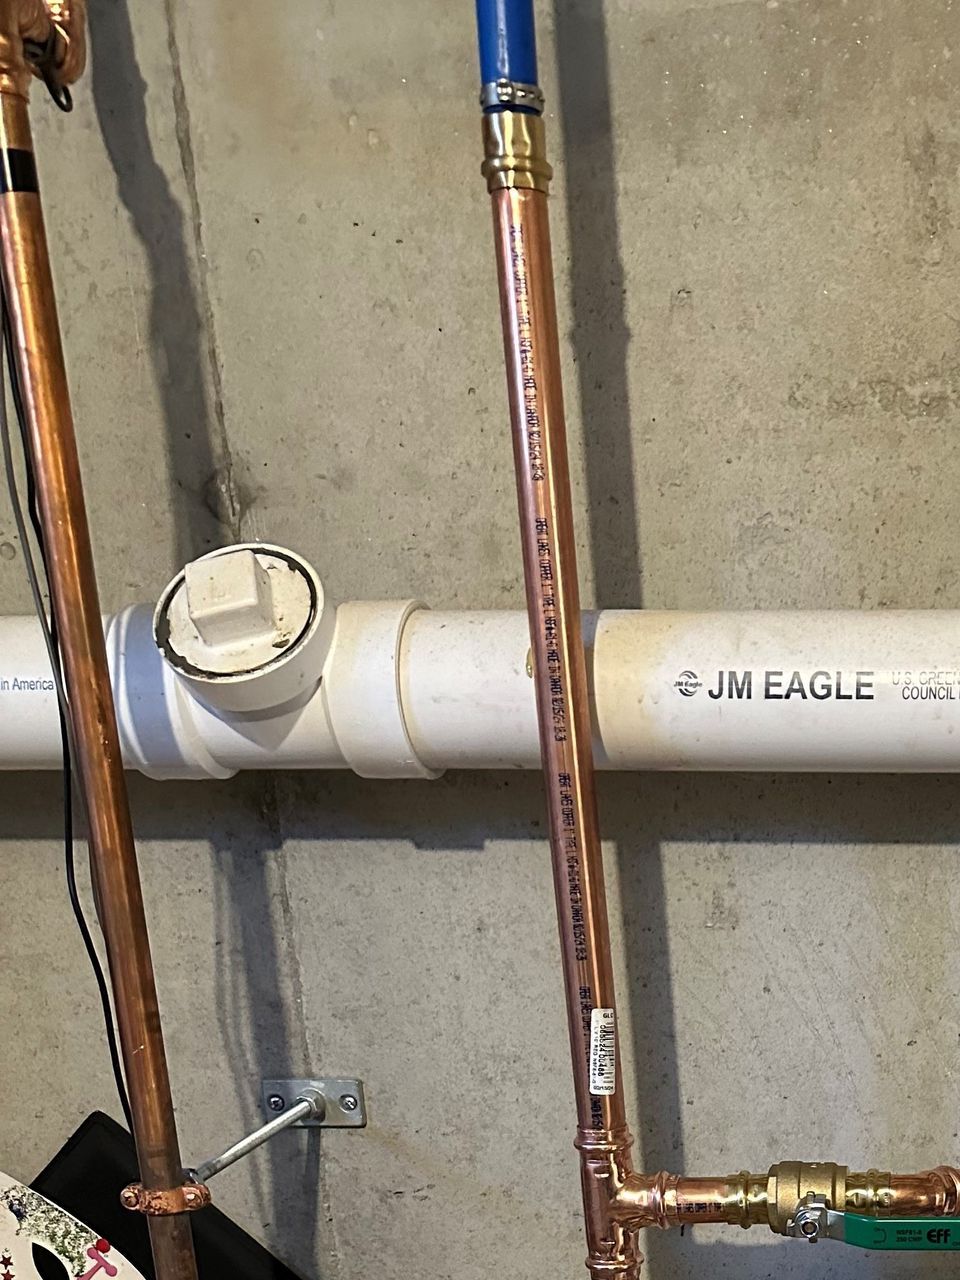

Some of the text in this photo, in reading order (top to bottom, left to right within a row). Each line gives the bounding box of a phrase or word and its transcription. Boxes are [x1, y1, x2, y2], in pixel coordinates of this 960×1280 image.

[1, 678, 54, 691] in America
[708, 670, 752, 700] JM
[764, 670, 875, 700] EAGLE
[902, 686, 956, 700] COUNCIL
